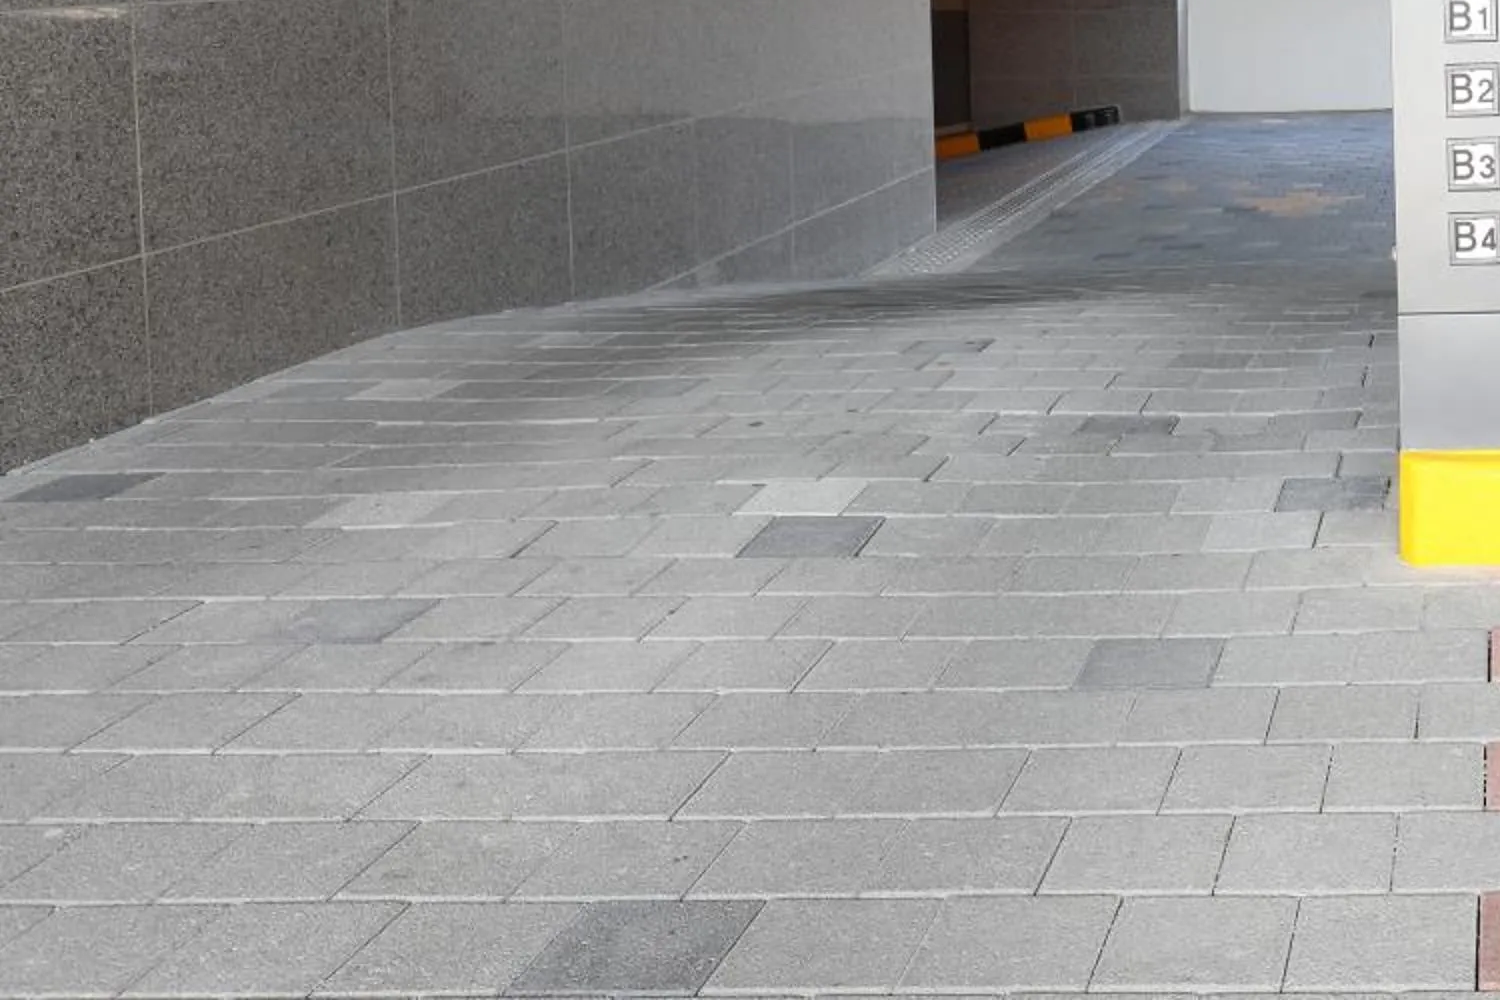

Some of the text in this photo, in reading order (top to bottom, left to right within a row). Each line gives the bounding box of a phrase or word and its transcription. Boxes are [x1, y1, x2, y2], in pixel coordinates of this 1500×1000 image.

[1449, 0, 1490, 32] B1
[1450, 73, 1495, 105] B2
[1452, 148, 1496, 181] B3
[1453, 221, 1497, 253] B4
